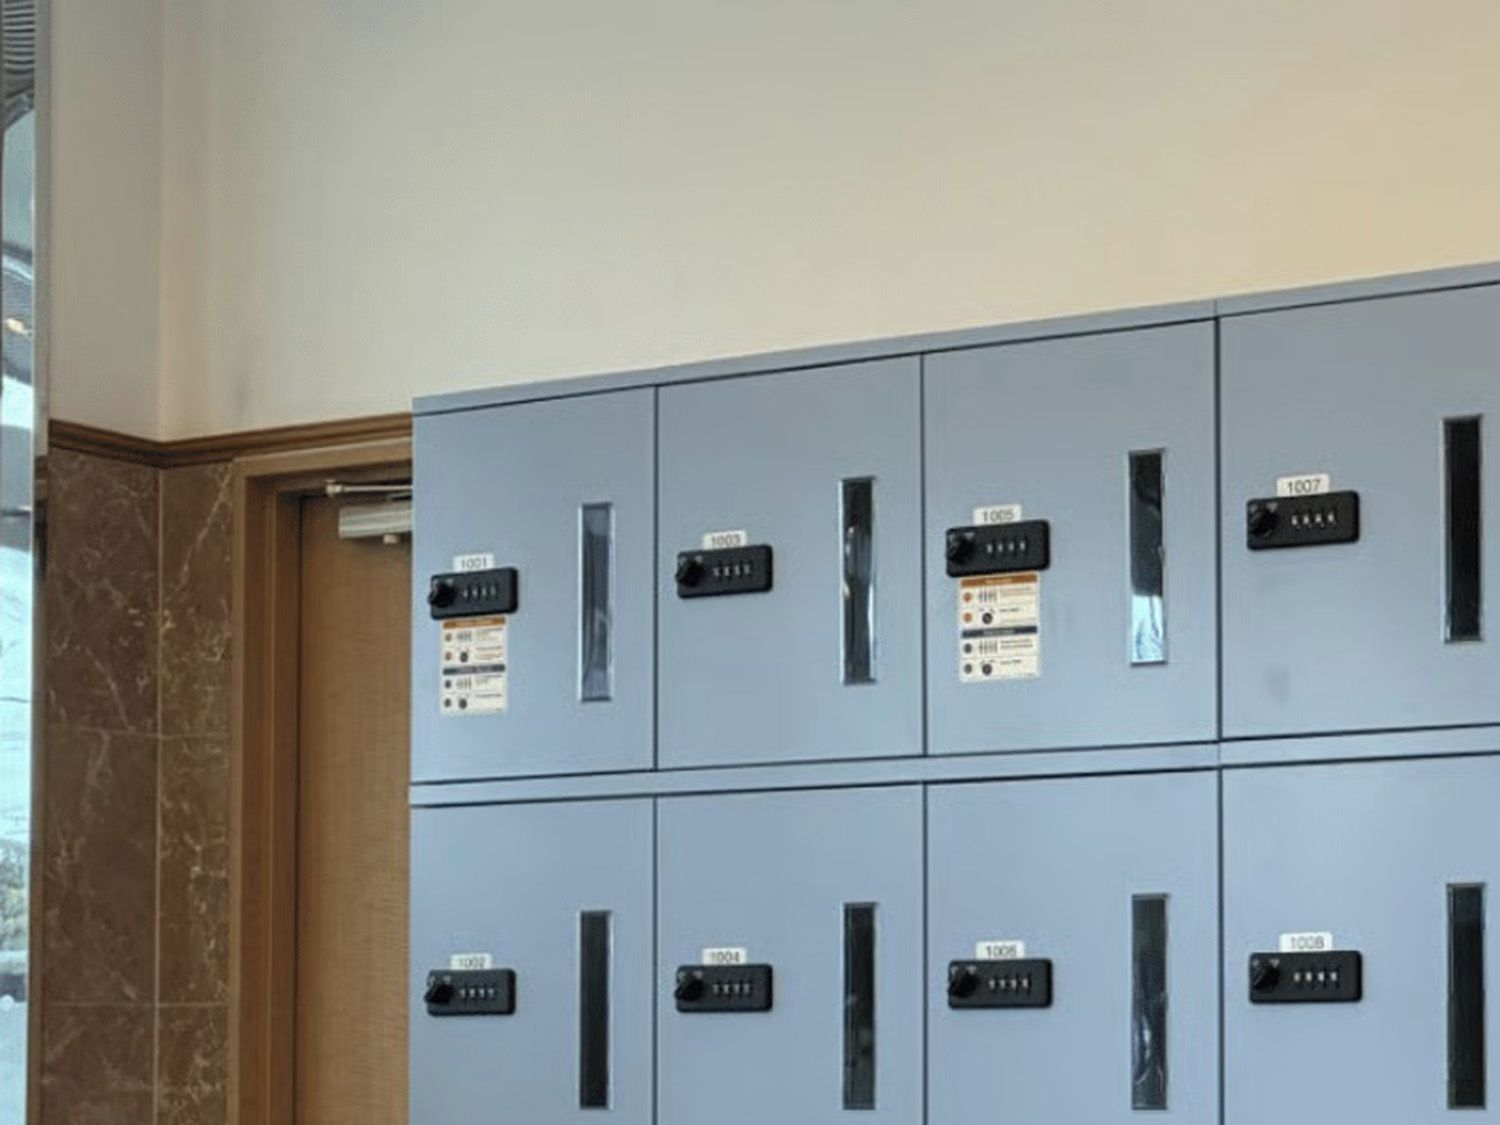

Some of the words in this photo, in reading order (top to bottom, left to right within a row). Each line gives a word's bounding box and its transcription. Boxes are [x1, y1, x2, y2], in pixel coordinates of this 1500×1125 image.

[1286, 478, 1321, 494] 1007
[981, 508, 1016, 523] 1005
[709, 533, 742, 547] 1003
[460, 556, 488, 569] 1001
[458, 956, 486, 969] 1002
[709, 952, 741, 964] 1004
